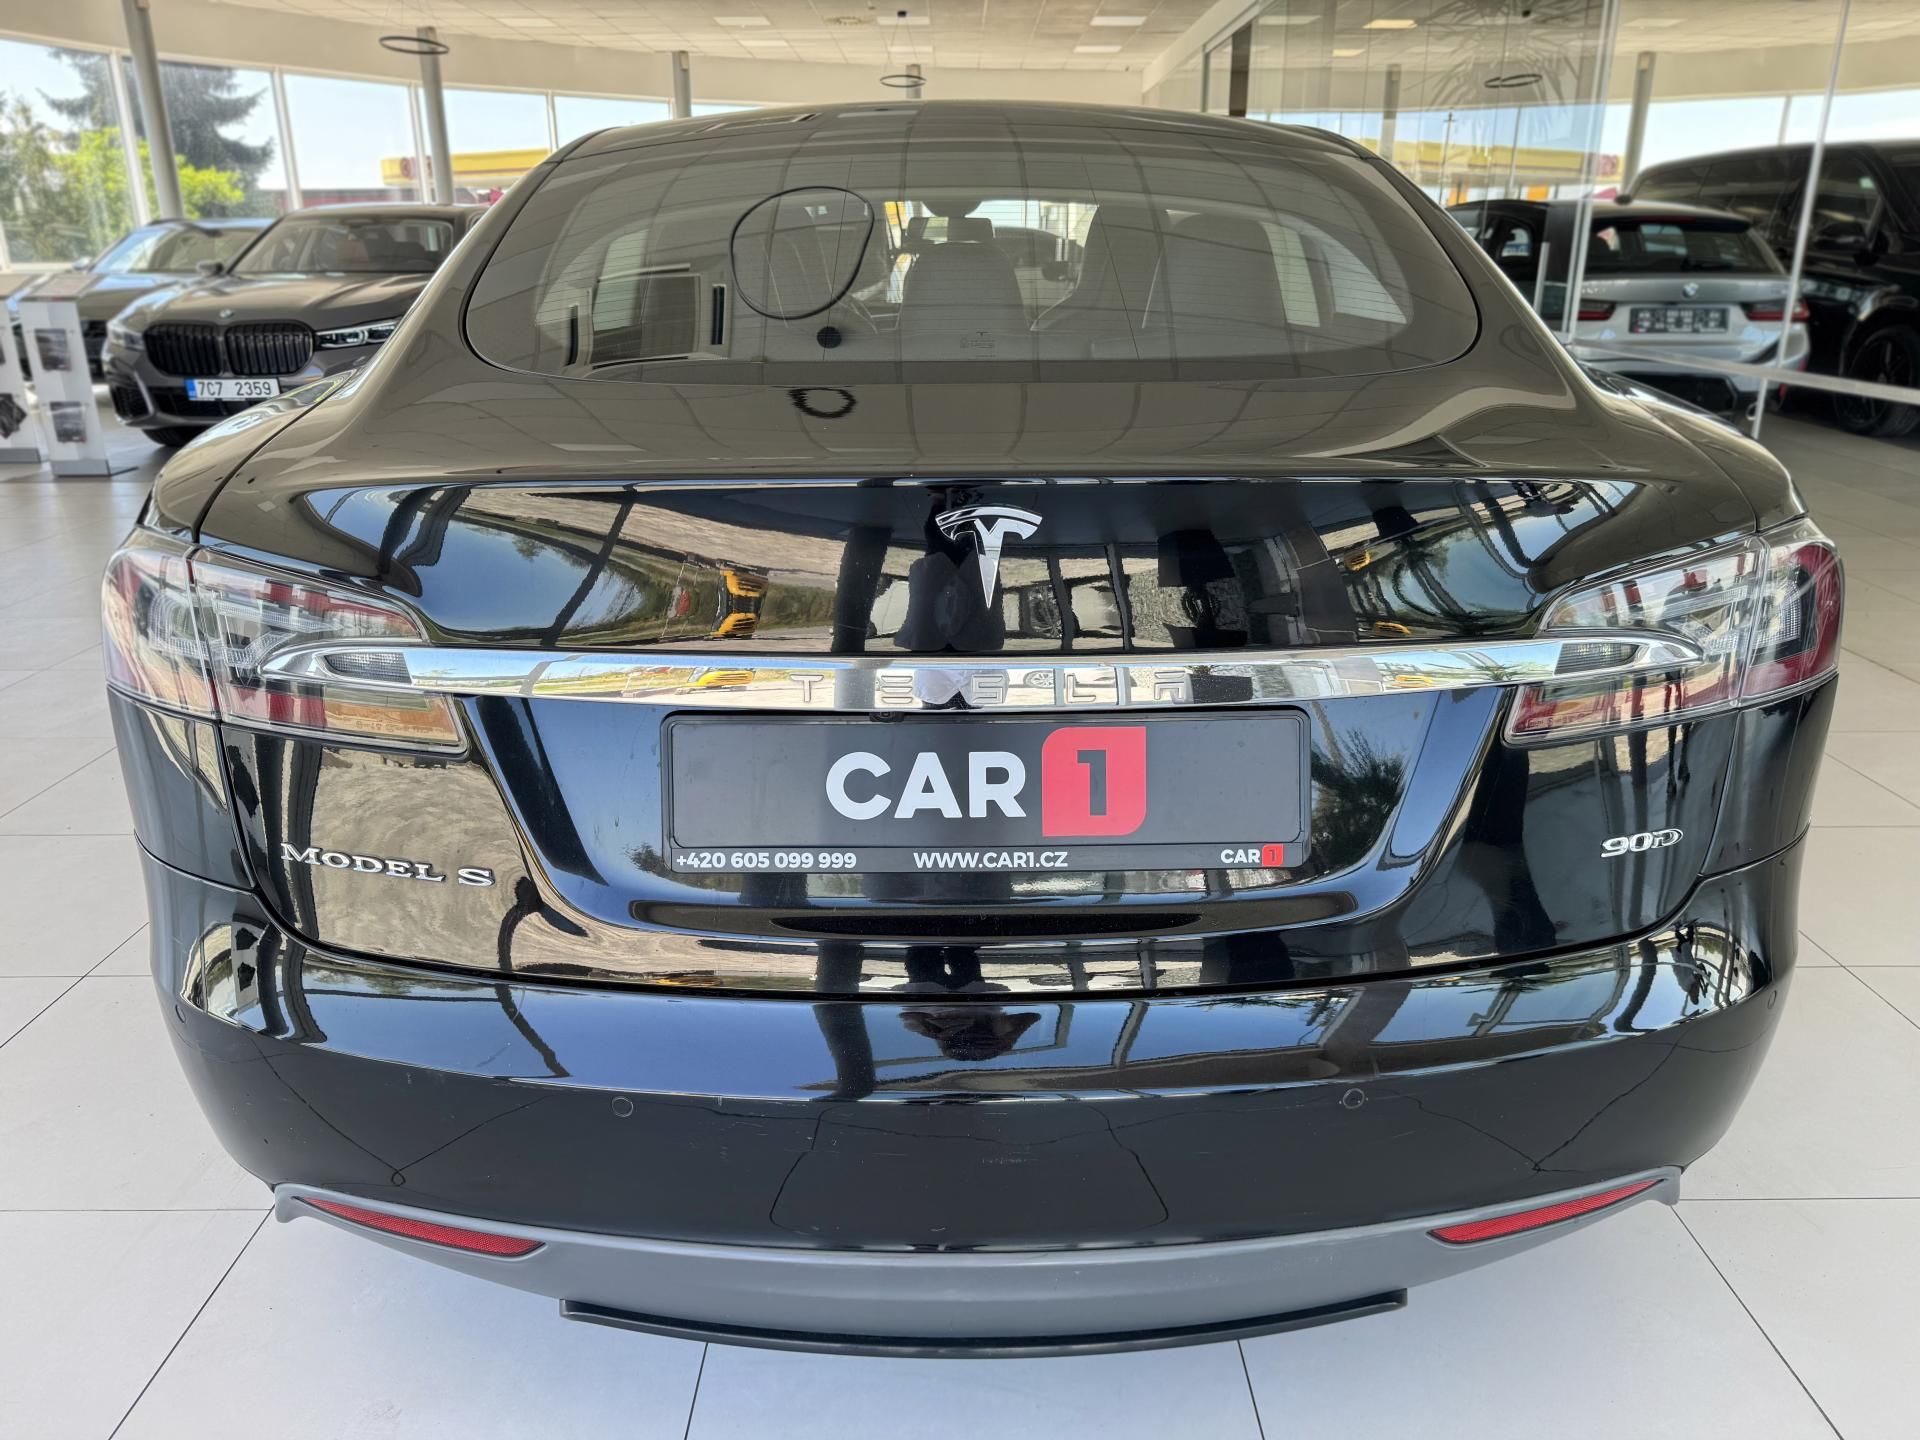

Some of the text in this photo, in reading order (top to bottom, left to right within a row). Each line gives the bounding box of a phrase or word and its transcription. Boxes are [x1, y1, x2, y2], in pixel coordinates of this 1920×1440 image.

[197, 381, 272, 397] 7C7 2359
[789, 670, 1190, 706] TESLA
[280, 842, 496, 888] MODEL S
[676, 852, 857, 869] +420 605 099 999
[913, 851, 1069, 869] WWW.CAR1.CZ
